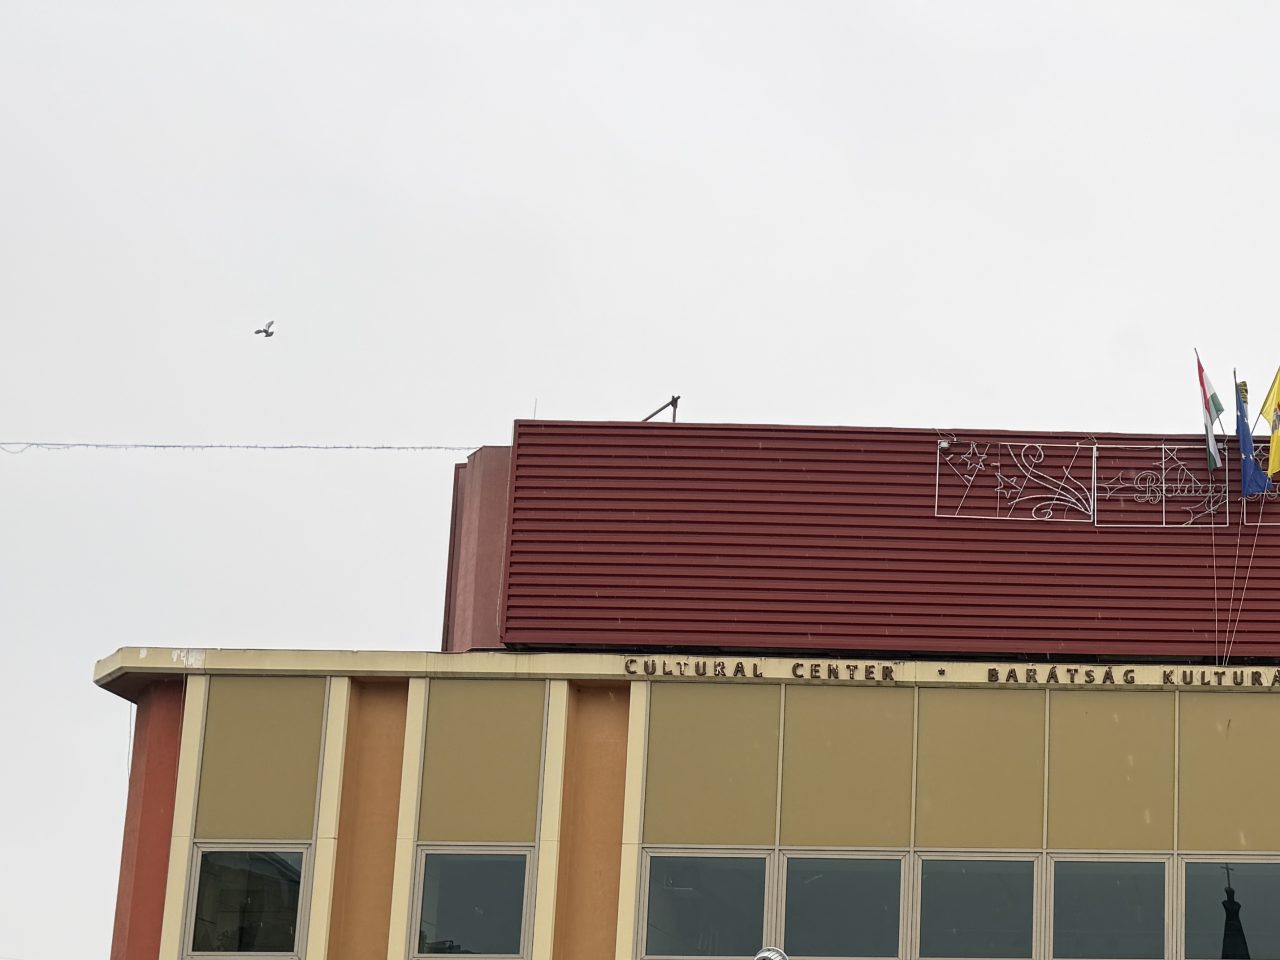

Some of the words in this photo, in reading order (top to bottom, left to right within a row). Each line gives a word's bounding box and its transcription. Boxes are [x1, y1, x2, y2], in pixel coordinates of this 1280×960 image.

[625, 658, 763, 678] CULTURAL
[791, 662, 895, 681] CENTER
[987, 665, 1136, 685] BARÁTSÁG
